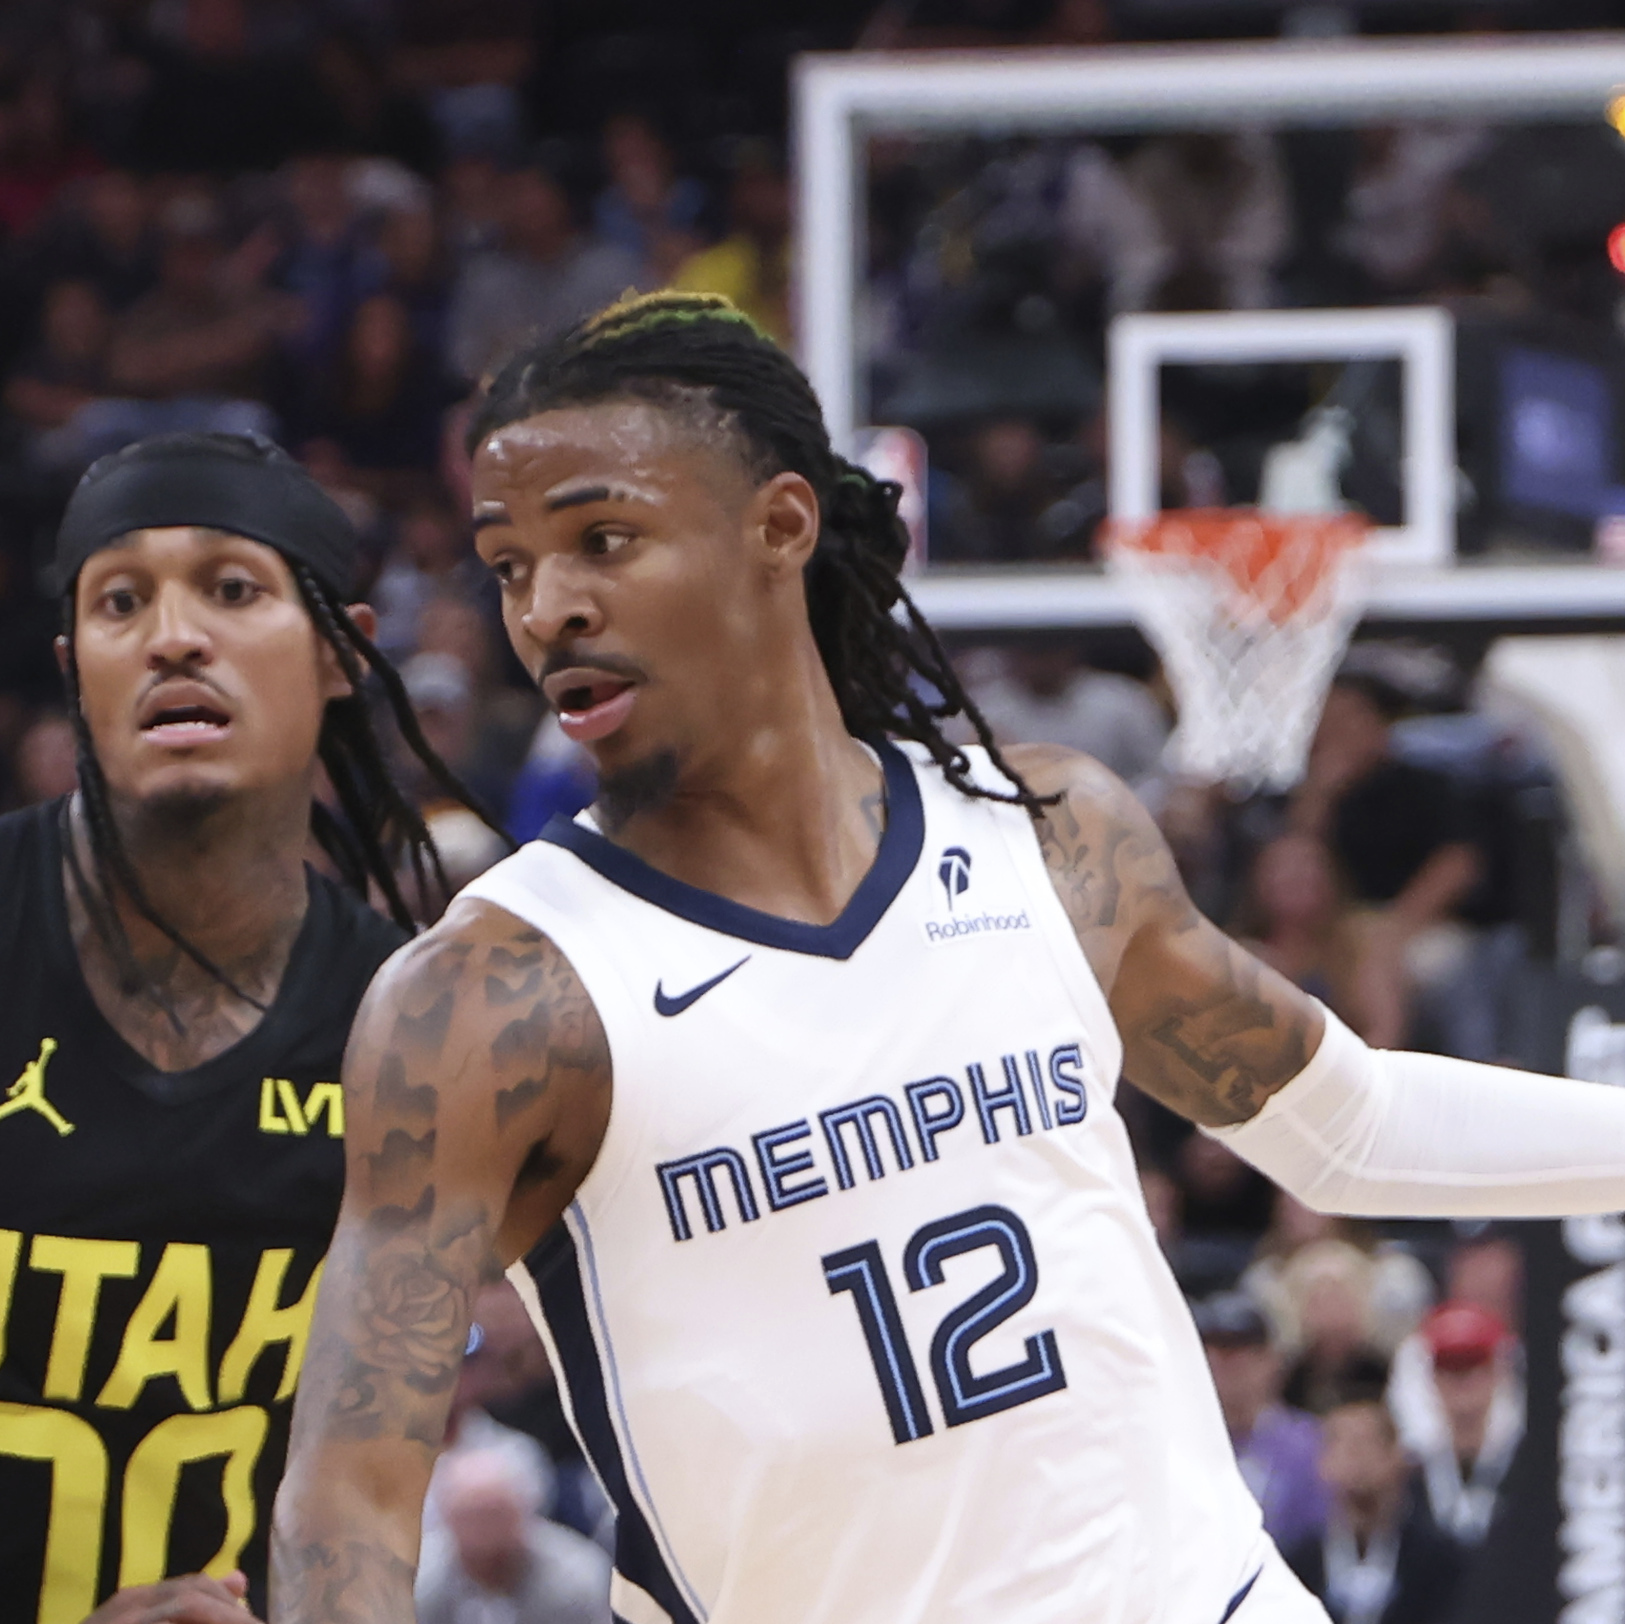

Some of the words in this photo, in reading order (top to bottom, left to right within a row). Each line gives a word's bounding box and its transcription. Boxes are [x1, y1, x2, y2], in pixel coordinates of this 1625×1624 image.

[925, 909, 1030, 942] Robinhood
[654, 1043, 1088, 1243] MEMPHIS
[821, 1203, 1068, 1446] 12
